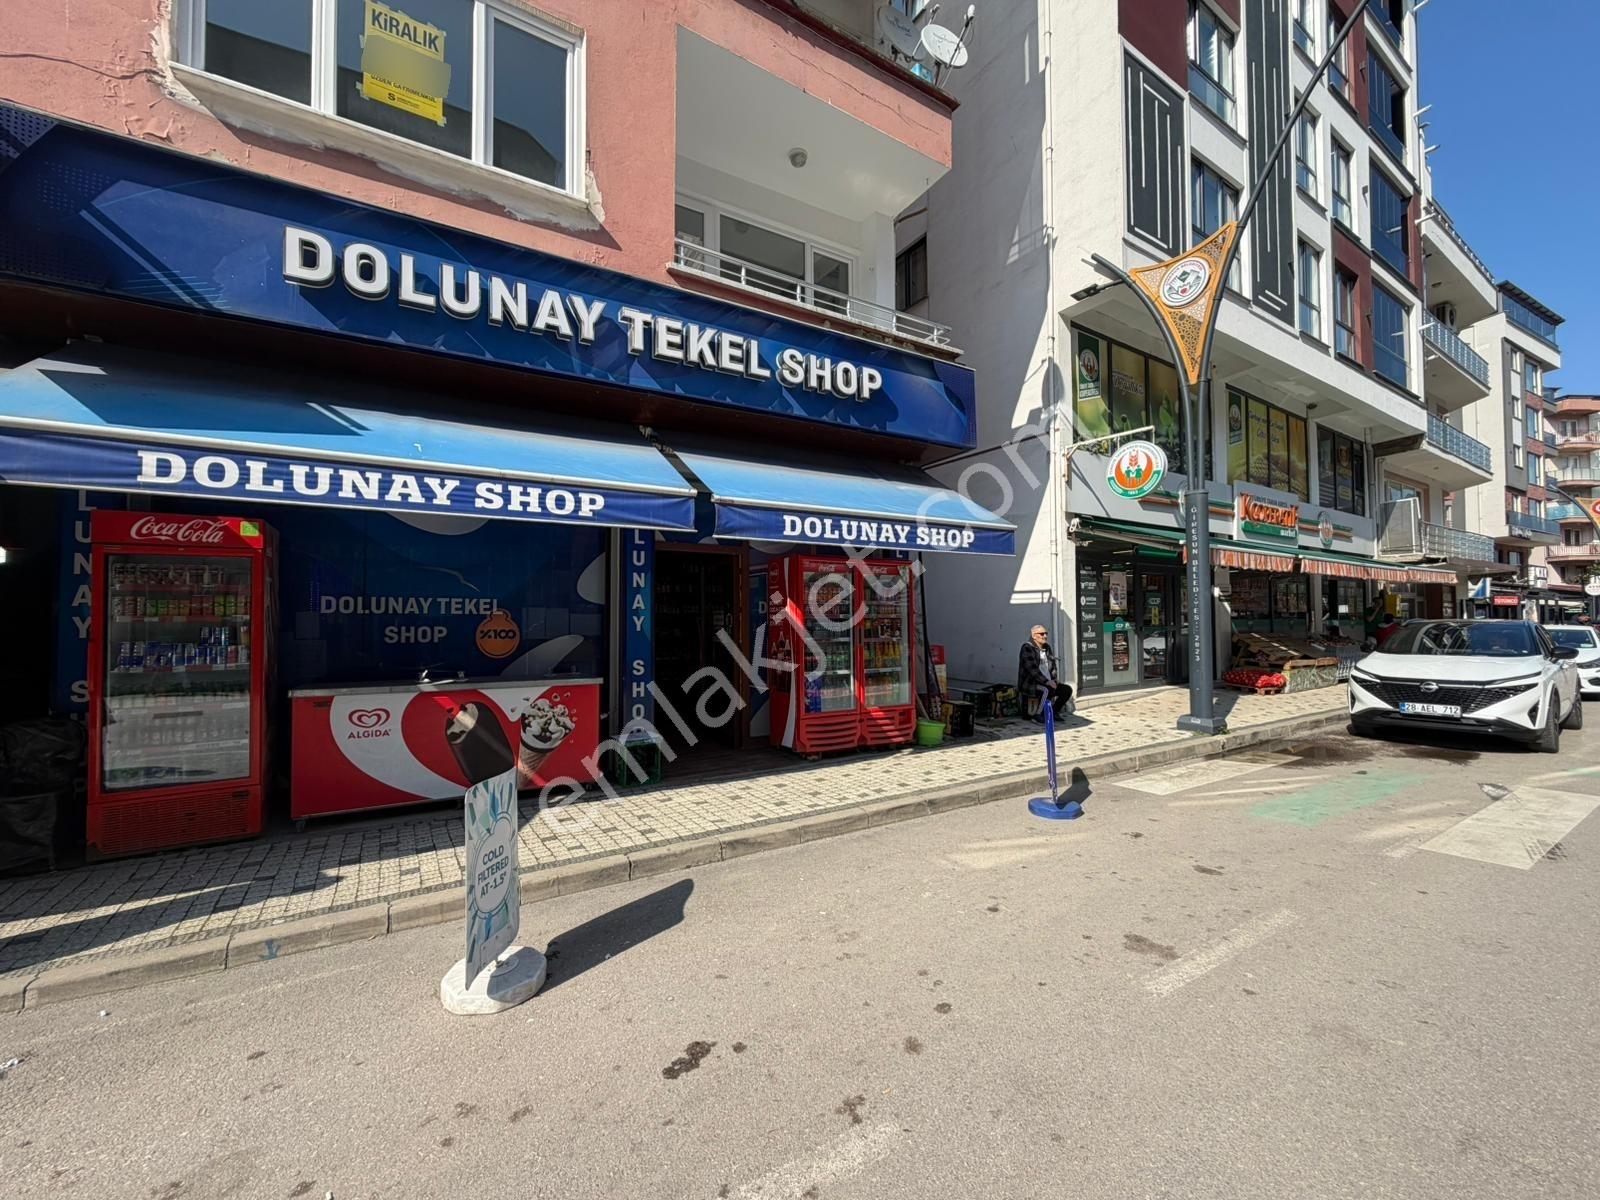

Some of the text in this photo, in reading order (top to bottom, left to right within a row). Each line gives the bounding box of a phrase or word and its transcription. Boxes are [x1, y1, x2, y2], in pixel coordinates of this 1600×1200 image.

[282, 224, 884, 401] DOLUNAY TEKEL SHOP
[136, 450, 606, 517] DOLUNAY SHOP
[130, 516, 230, 543] Coca-Cola
[783, 514, 976, 549] DOLUNAY SHOP
[320, 595, 503, 616] DOLUNAY TEKEL
[384, 626, 448, 644] SHOP
[1406, 703, 1417, 712] 28
[1421, 704, 1435, 713] AEL
[482, 844, 505, 866] COLD
[477, 855, 510, 885] FILTERED
